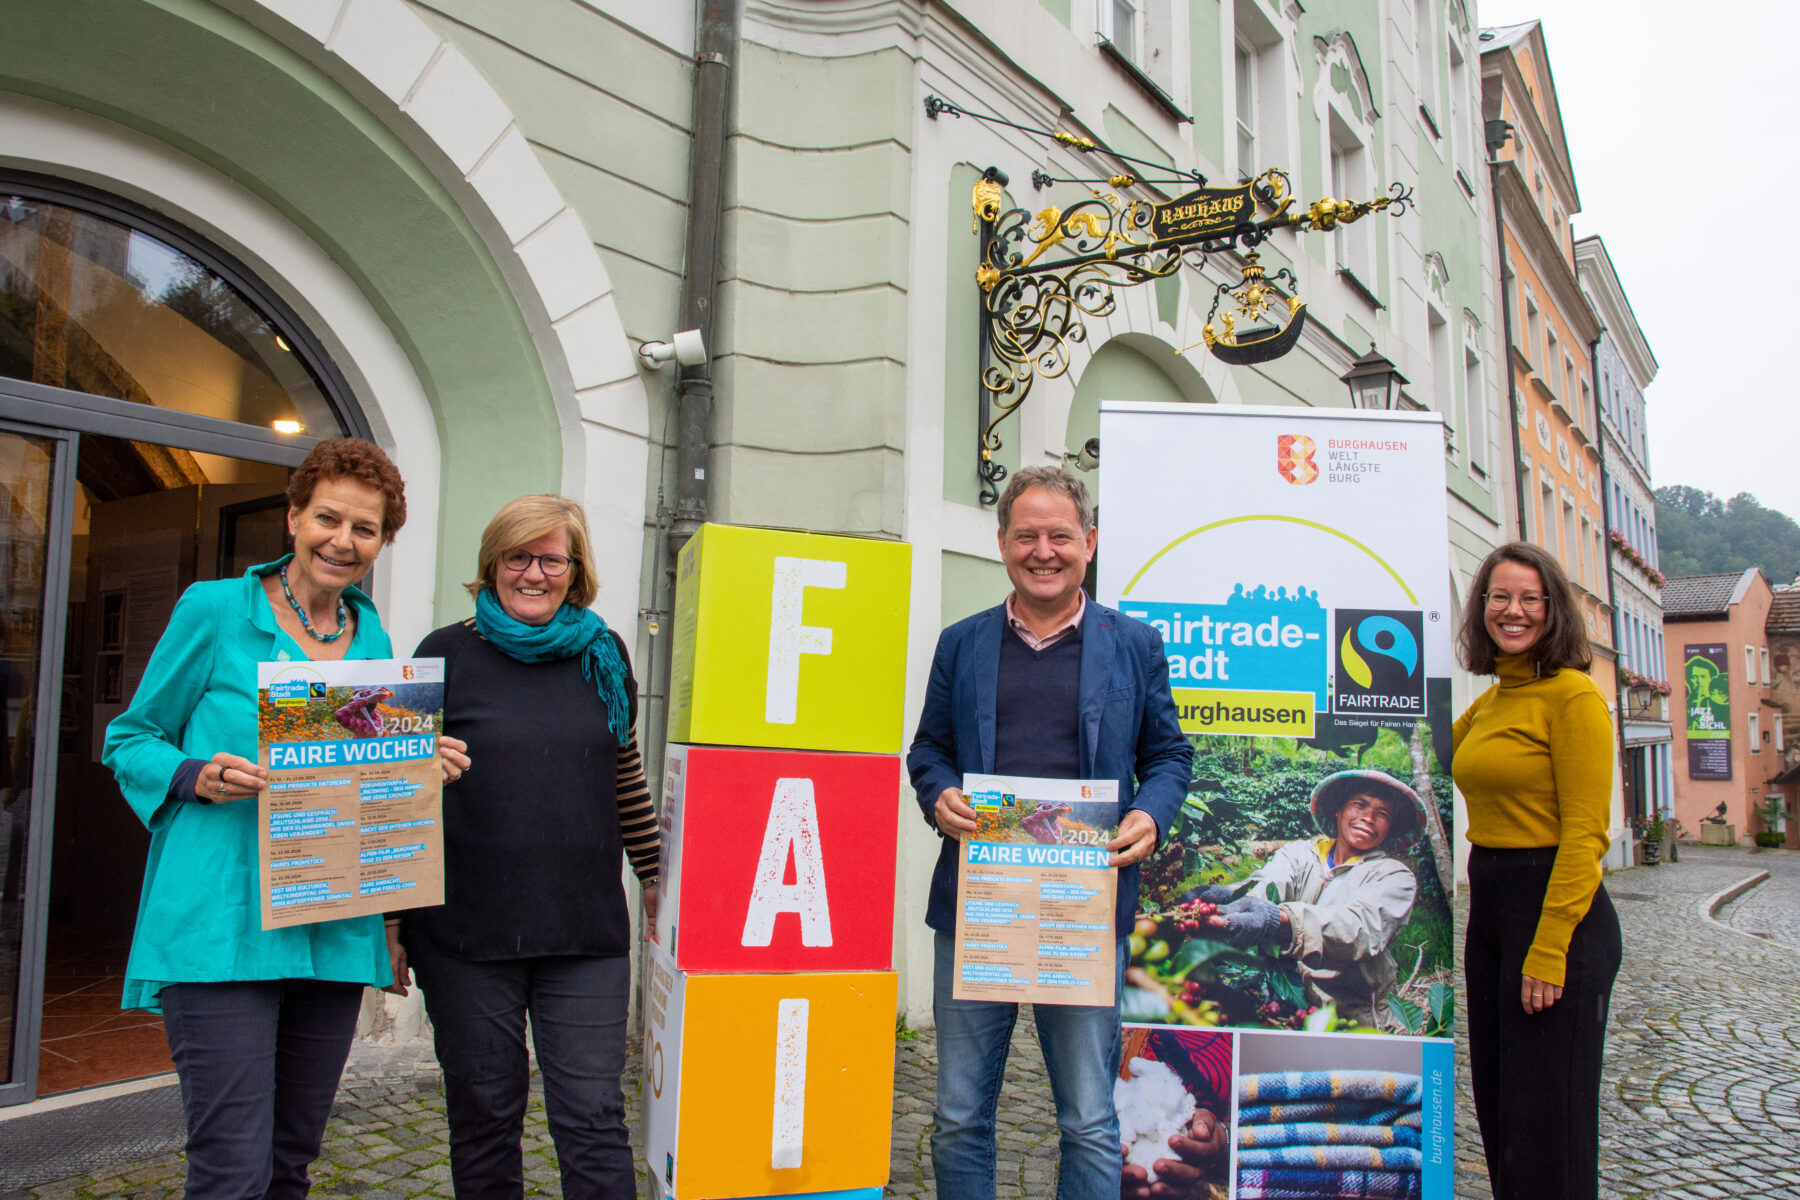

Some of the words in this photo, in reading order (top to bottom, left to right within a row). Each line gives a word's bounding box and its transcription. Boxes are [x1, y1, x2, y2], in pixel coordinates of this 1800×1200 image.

[1160, 194, 1244, 224] RATHAUS
[1328, 440, 1407, 450] BURGHAUSEN
[1328, 452, 1358, 460] WELT
[1329, 462, 1380, 472] LÄNGSTE
[1329, 474, 1360, 483] BURG
[765, 556, 847, 724] F
[1125, 611, 1320, 648] airtrade-
[1168, 648, 1229, 680] adt
[1340, 694, 1420, 708] FAIRTRADE
[1691, 707, 1712, 716] JAZZ
[1176, 702, 1306, 725] urghausen
[390, 716, 434, 734] 2024
[1700, 722, 1727, 730] BICHL
[270, 744, 336, 766] FAIRE
[343, 738, 434, 762] WOCHEN
[1068, 830, 1110, 845] 2024
[741, 777, 833, 947] A
[968, 845, 1021, 863] FAIRE
[1028, 848, 1110, 867] WOCHEN
[772, 998, 810, 1168] I
[1430, 1070, 1445, 1164] burghausen.de
